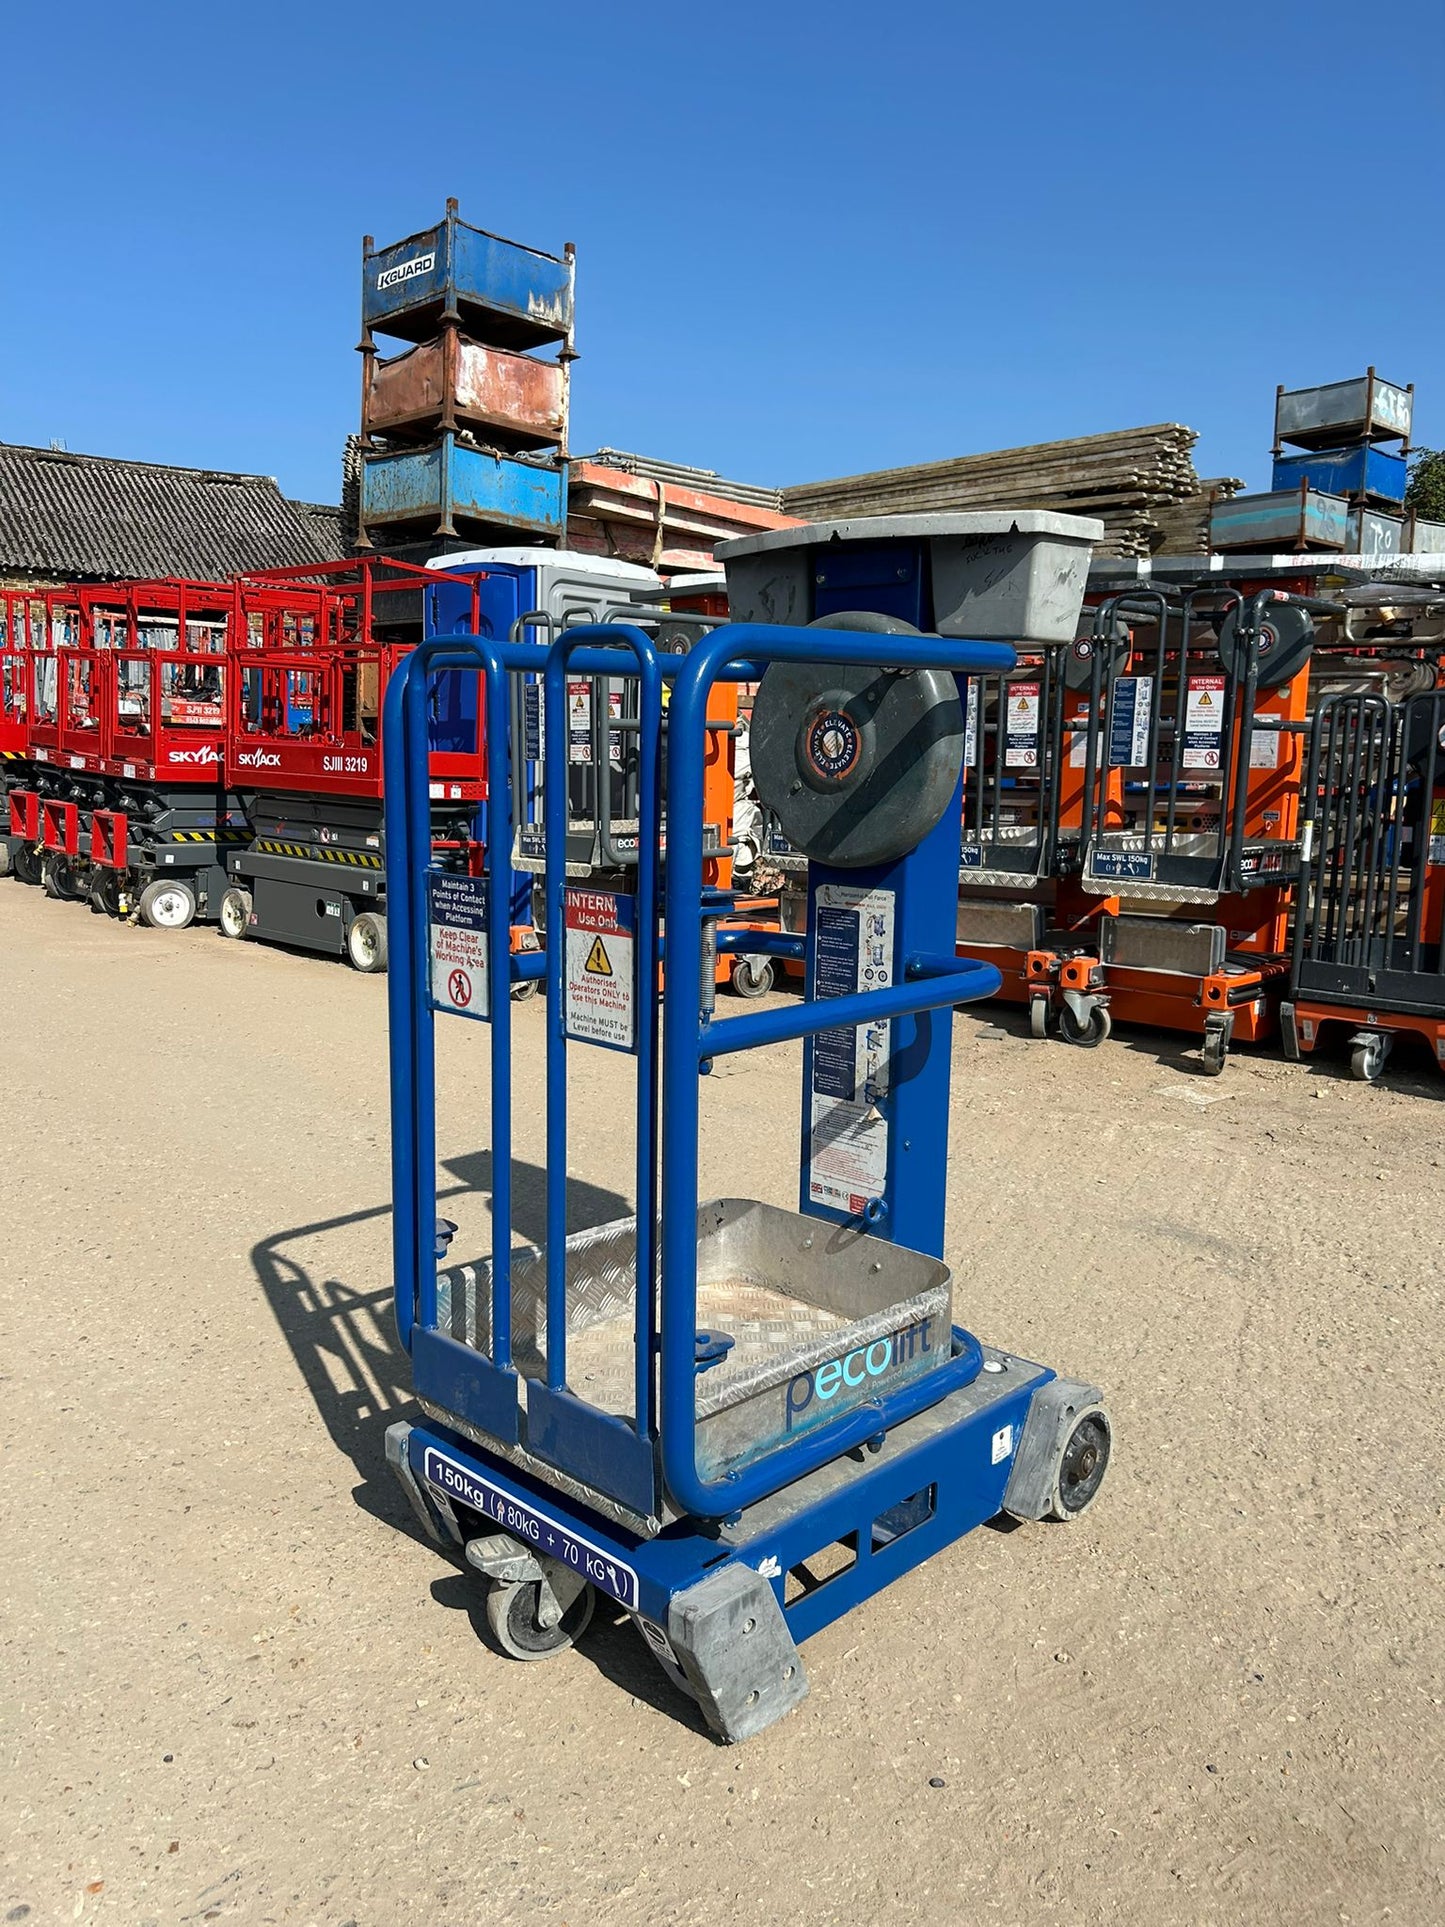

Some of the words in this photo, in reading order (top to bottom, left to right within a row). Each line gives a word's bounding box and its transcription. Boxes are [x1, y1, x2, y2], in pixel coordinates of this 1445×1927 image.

[379, 258, 432, 288] KGUARD
[169, 745, 225, 765] SKYJAC
[238, 748, 281, 768] SKYJACK
[323, 756, 343, 771] SJIII
[345, 757, 368, 772] 3219
[1128, 855, 1148, 864] 150kg
[442, 880, 469, 891] Maintain
[470, 884, 475, 892] 3
[432, 889, 452, 900] Points
[453, 892, 460, 901] of
[460, 893, 486, 905] Contact
[568, 892, 617, 912] INTERN
[435, 901, 450, 910] when
[452, 902, 484, 917] Accessing
[445, 912, 473, 924] Platform
[578, 912, 596, 925] Use
[598, 914, 618, 932] Only
[439, 928, 457, 941] Keep
[459, 931, 479, 944] Clear
[436, 940, 444, 949] of
[445, 941, 482, 956] Machine's
[435, 950, 464, 966] Working
[581, 974, 617, 988] Authorised
[569, 982, 600, 995] Operators
[602, 988, 621, 999] ONLY
[622, 992, 630, 1001] to
[585, 995, 598, 1006] this
[599, 999, 626, 1011] Machine
[570, 1011, 597, 1025] Machine
[599, 1016, 618, 1029] MUST
[620, 1021, 628, 1032] be
[573, 1022, 590, 1032] Level
[592, 1025, 612, 1038] before
[614, 1031, 625, 1041] use
[786, 1318, 931, 1432] pecolift
[436, 1462, 484, 1509] 150kg
[563, 1539, 579, 1565] 70
